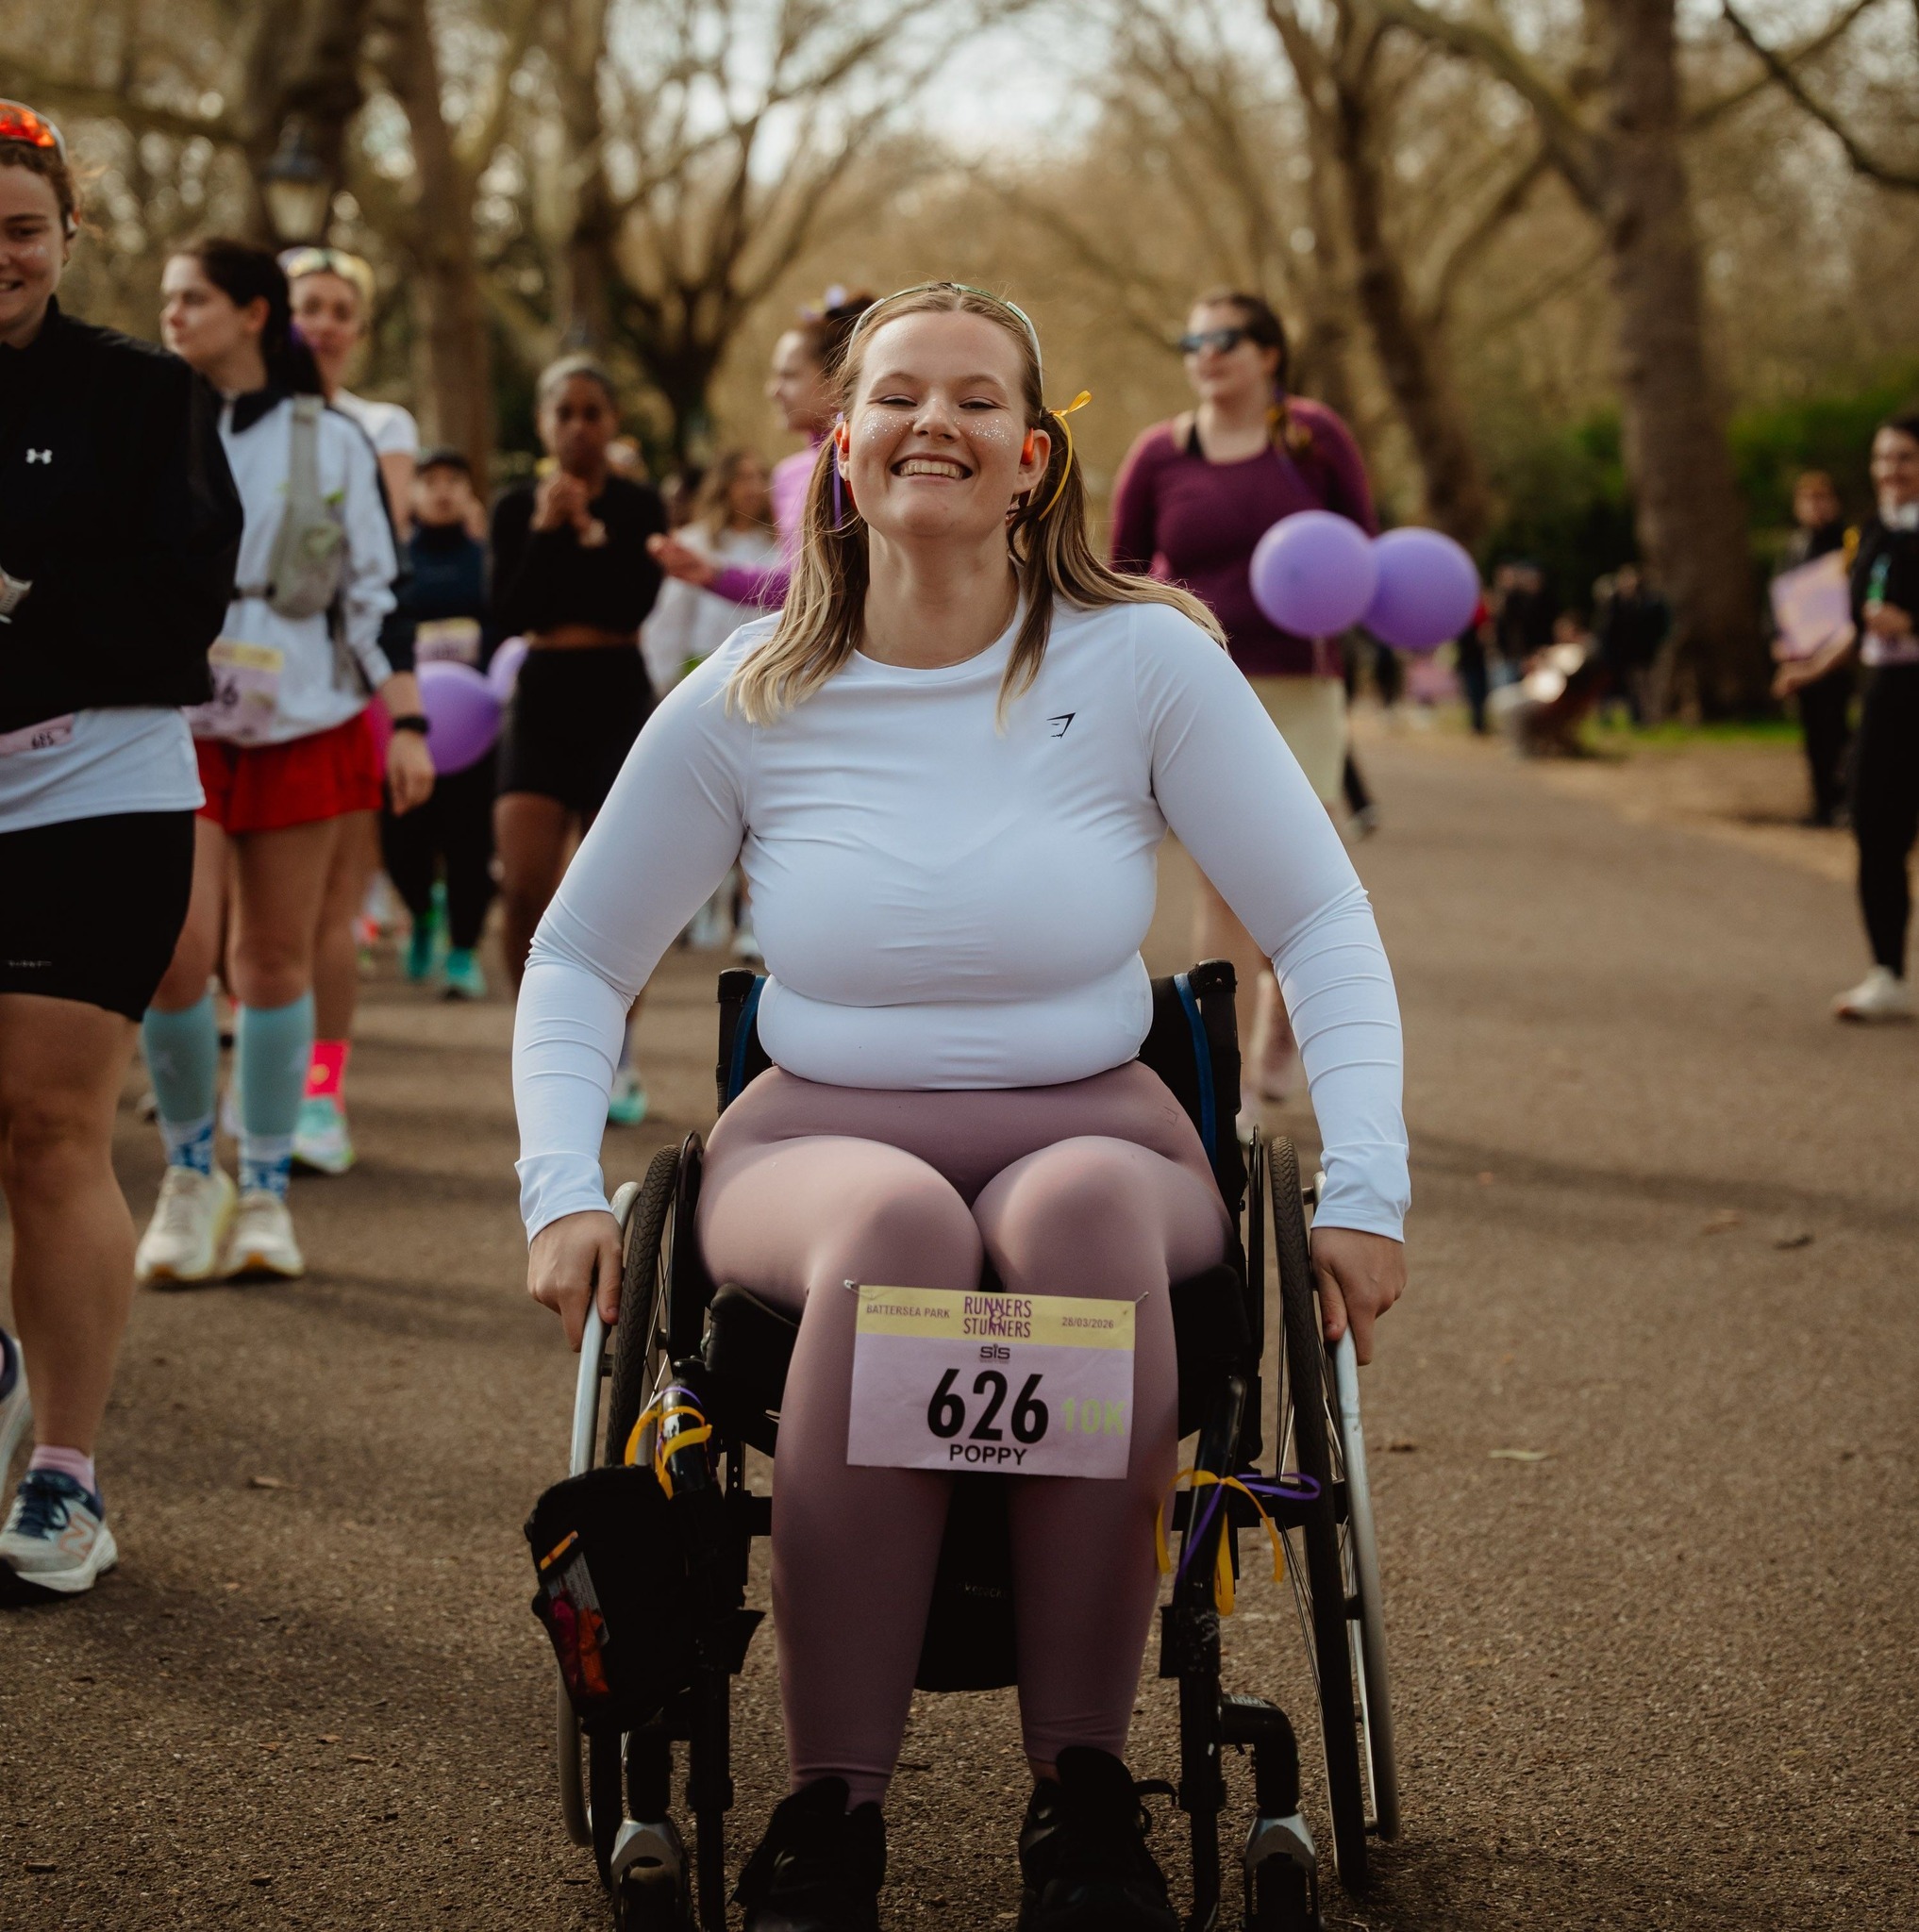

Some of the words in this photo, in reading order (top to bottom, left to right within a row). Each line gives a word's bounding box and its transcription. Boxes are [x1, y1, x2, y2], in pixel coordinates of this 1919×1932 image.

[866, 1304, 922, 1318] BATTERSEA
[924, 1307, 950, 1319] PARK
[964, 1296, 1032, 1319] RUNNERS
[963, 1318, 1031, 1338] STUNNERS
[1061, 1317, 1114, 1329] 28/03/2026
[927, 1368, 1049, 1444] 626
[1061, 1397, 1126, 1436] 10K
[950, 1444, 1027, 1465] POPPY
